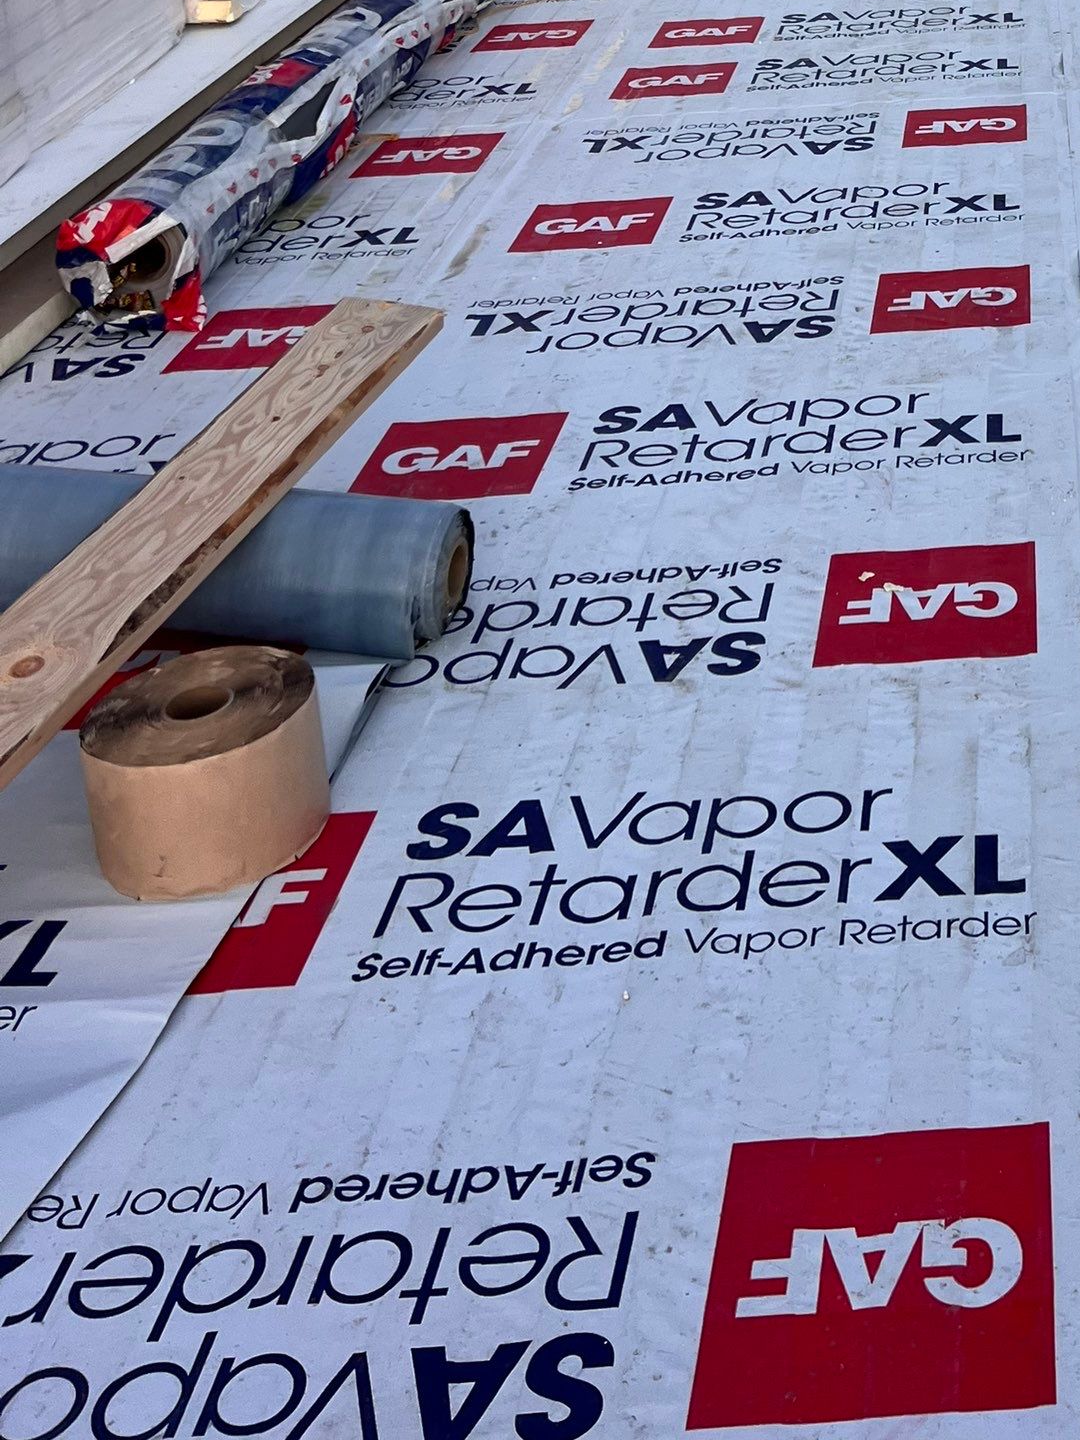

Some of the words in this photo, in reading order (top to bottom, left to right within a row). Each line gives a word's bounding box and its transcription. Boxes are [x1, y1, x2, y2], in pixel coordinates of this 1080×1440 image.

[488, 29, 577, 42] GAF
[665, 25, 752, 38] GAF
[628, 73, 724, 88] GAF
[746, 77, 872, 92] Self-Adhered
[583, 120, 876, 154] RetarderXL
[915, 118, 1016, 134] GAF
[373, 147, 482, 163] GAF
[535, 213, 654, 234] GAF
[686, 193, 1020, 231] RetarderXL
[679, 224, 838, 242] Self-Adhered
[674, 276, 844, 296] Self-Adhered
[887, 287, 1017, 311] GAF
[465, 290, 839, 338] RetarderXL
[526, 315, 835, 353] SAVapor
[593, 393, 929, 434] SAVapor
[382, 440, 540, 474] GAF
[579, 414, 1021, 470] RetarderXL
[568, 463, 779, 491] Self-Adhered
[791, 459, 886, 475] Vapor
[896, 448, 1029, 468] Retarder
[468, 571, 536, 593] Vap
[549, 559, 782, 589] Self-Adhered
[839, 572, 1017, 624] GAF
[406, 788, 892, 860] SAVapor
[373, 834, 1026, 938] RetarderXL
[352, 930, 667, 982] Self-Adhered
[685, 927, 825, 959] Vapor
[839, 911, 1037, 945] Retarder
[105, 1178, 271, 1220] Vapor
[288, 1152, 655, 1210] Self-Adhered
[0, 1211, 639, 1342] Retarder
[735, 1218, 1022, 1317] GAF
[0, 1331, 614, 1440] SAVapo
